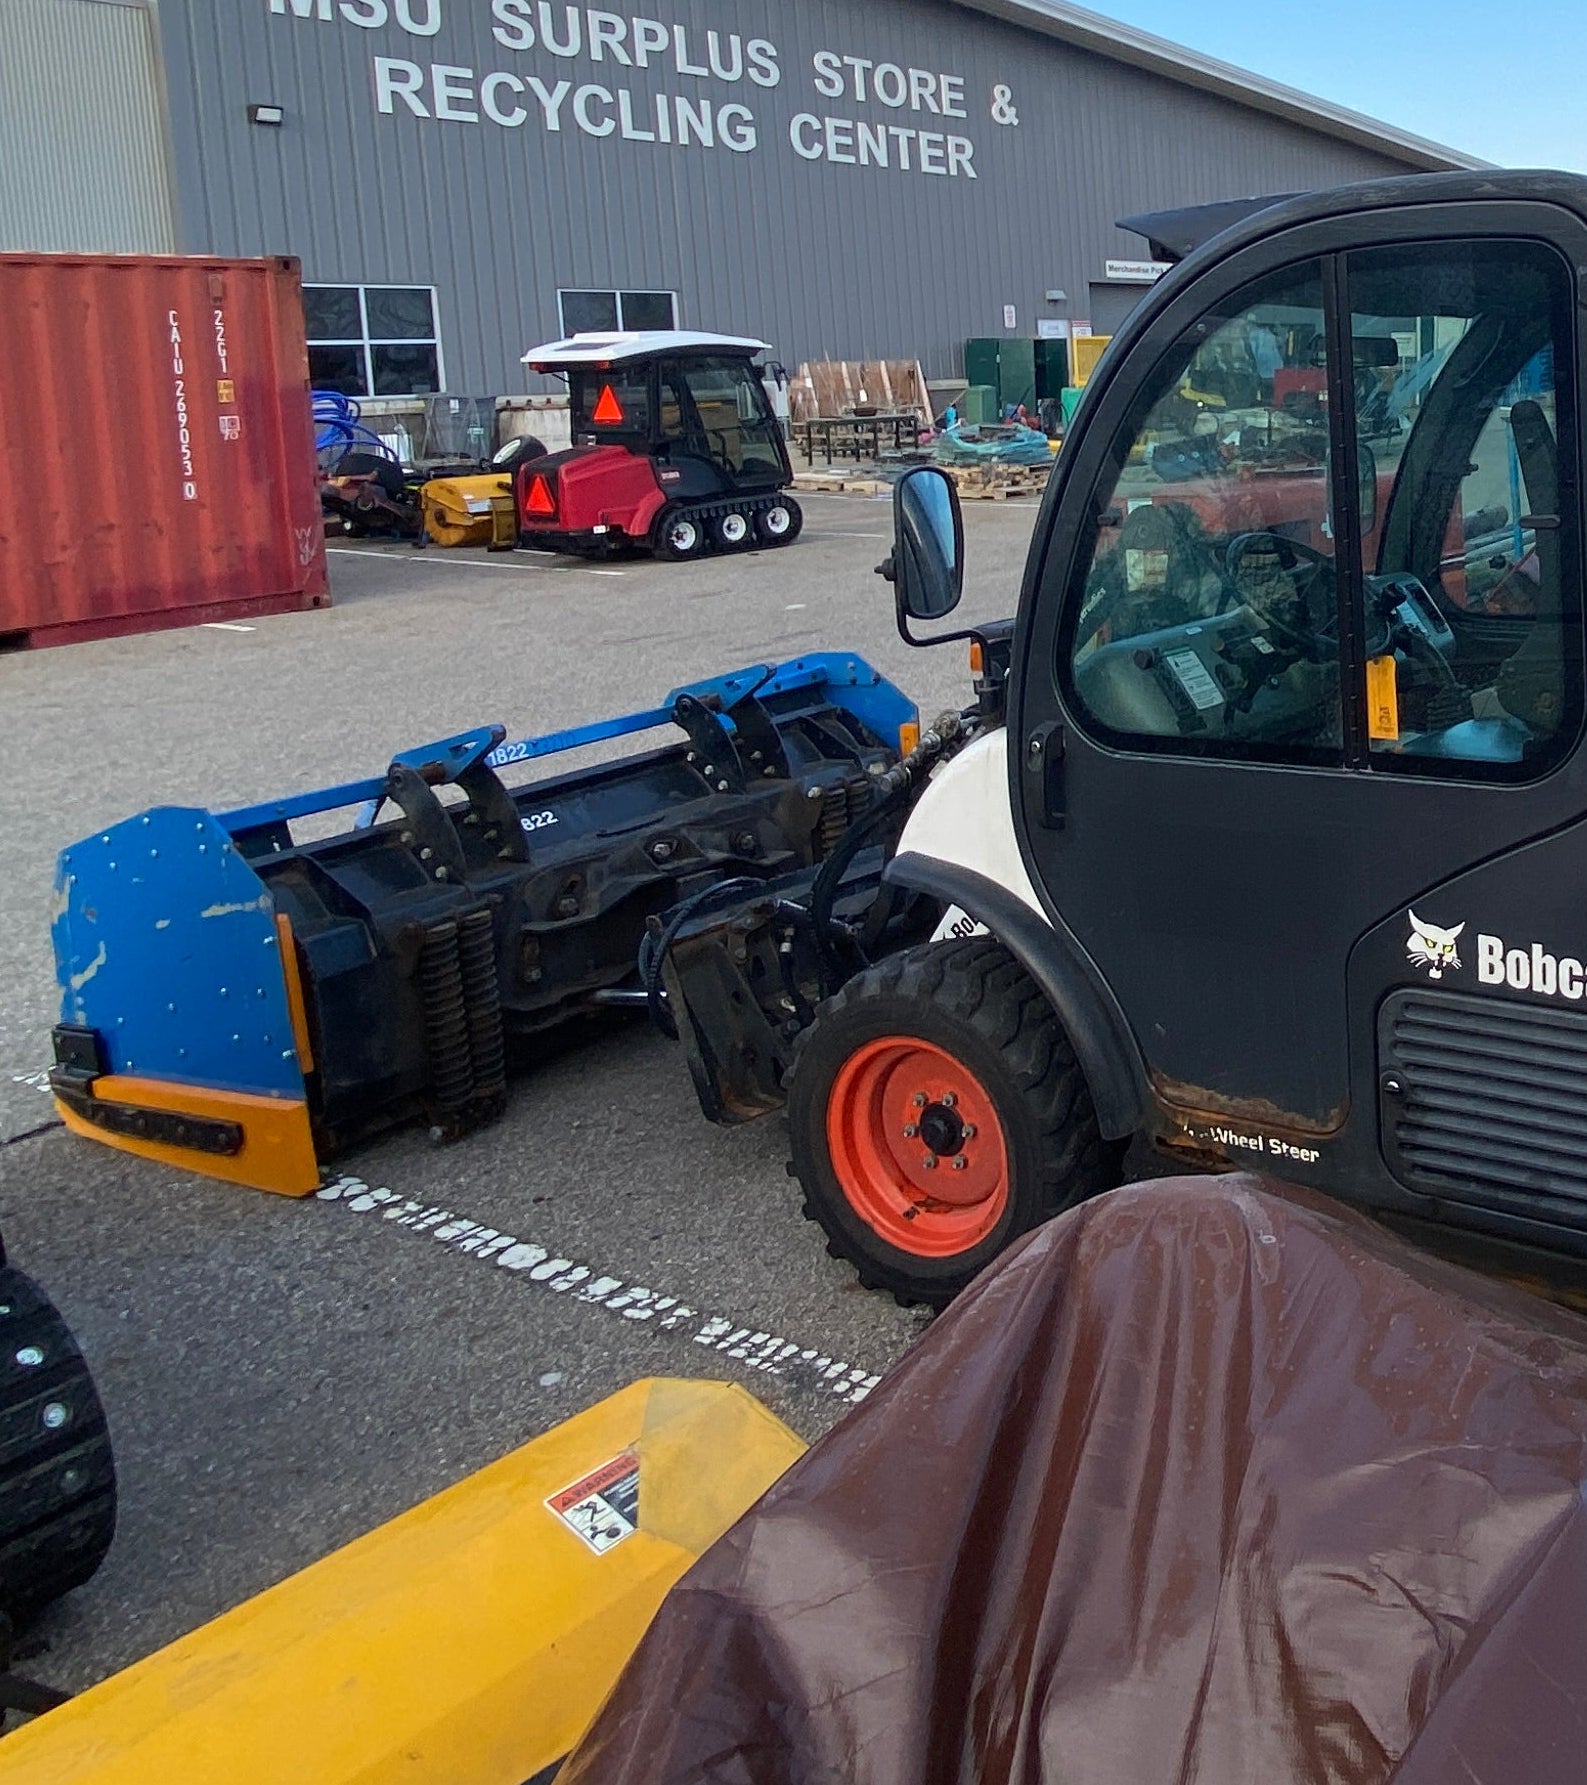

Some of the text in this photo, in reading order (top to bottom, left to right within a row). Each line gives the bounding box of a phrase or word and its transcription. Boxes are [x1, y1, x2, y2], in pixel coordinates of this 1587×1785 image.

[269, 0, 1019, 126] SU SURPLUS STORE &
[374, 56, 977, 178] RECYCLING CENTER
[175, 380, 193, 476] 269053
[488, 743, 530, 766] 1822
[1210, 1127, 1264, 1151] Wheel
[1268, 1138, 1320, 1163] Steer
